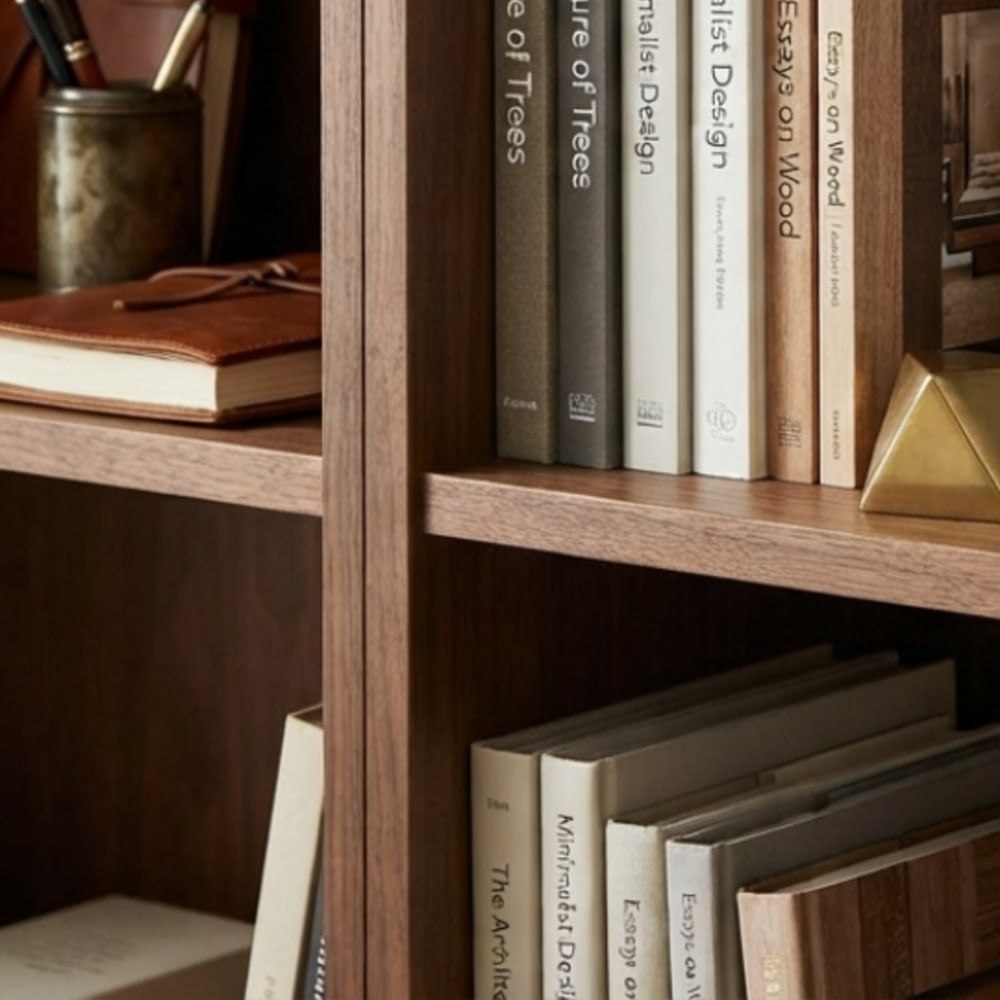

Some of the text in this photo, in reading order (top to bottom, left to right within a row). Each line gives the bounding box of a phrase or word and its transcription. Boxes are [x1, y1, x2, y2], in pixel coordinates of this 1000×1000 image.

[505, 29, 532, 63] of
[571, 59, 597, 93] of
[506, 71, 533, 166] Trees
[571, 99, 597, 189] Trees
[704, 64, 734, 170] Design
[777, 104, 796, 143] on
[827, 104, 842, 134] on
[777, 152, 802, 240] Wood
[826, 139, 846, 208] Wood
[490, 863, 511, 910] The
